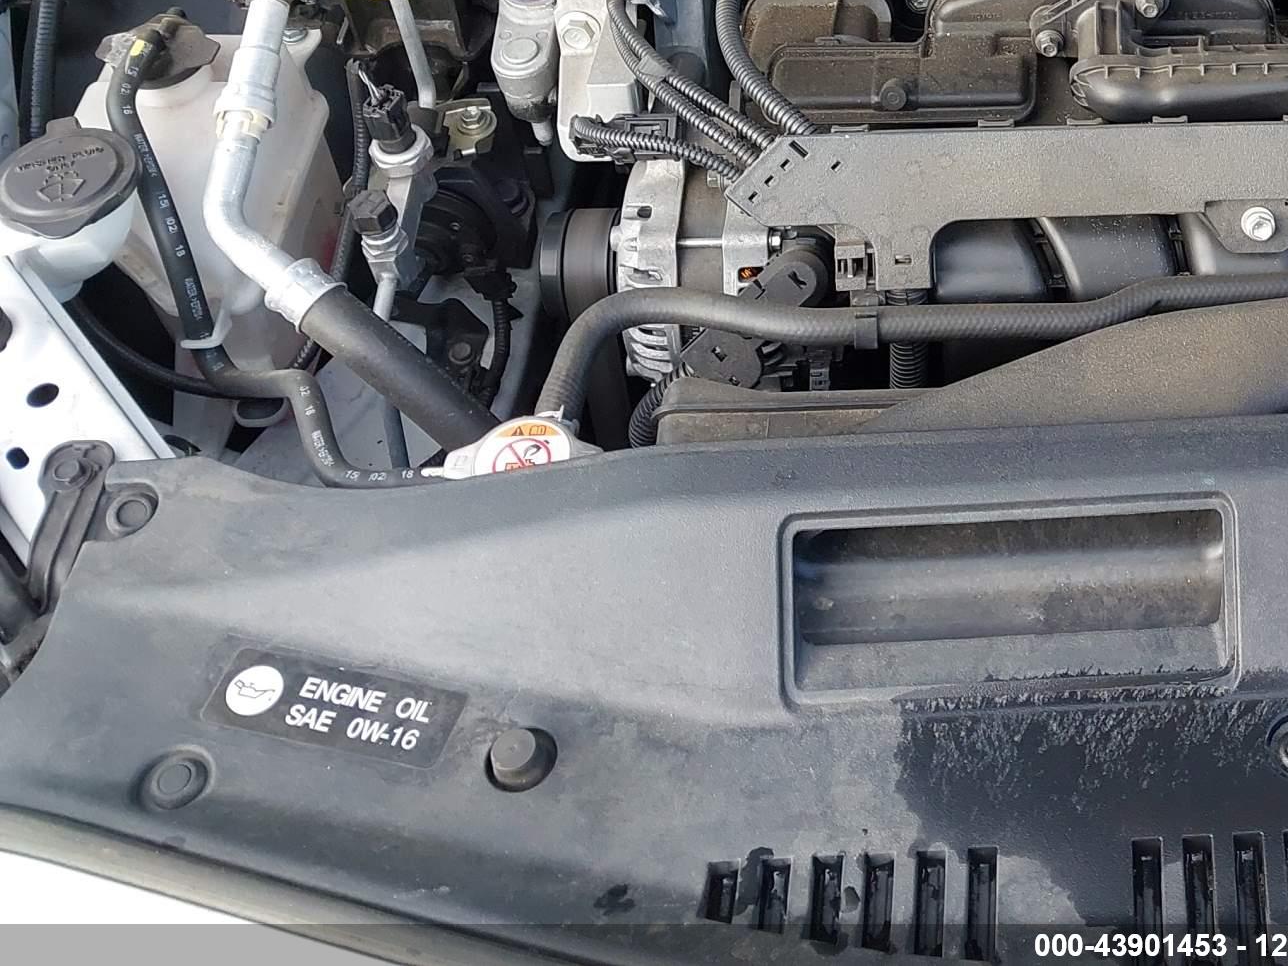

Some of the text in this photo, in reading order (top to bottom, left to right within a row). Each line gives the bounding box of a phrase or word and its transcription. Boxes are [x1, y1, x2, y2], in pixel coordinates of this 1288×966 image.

[298, 676, 431, 723] ENGINE OIL
[284, 704, 421, 751] SAE 0W-16
